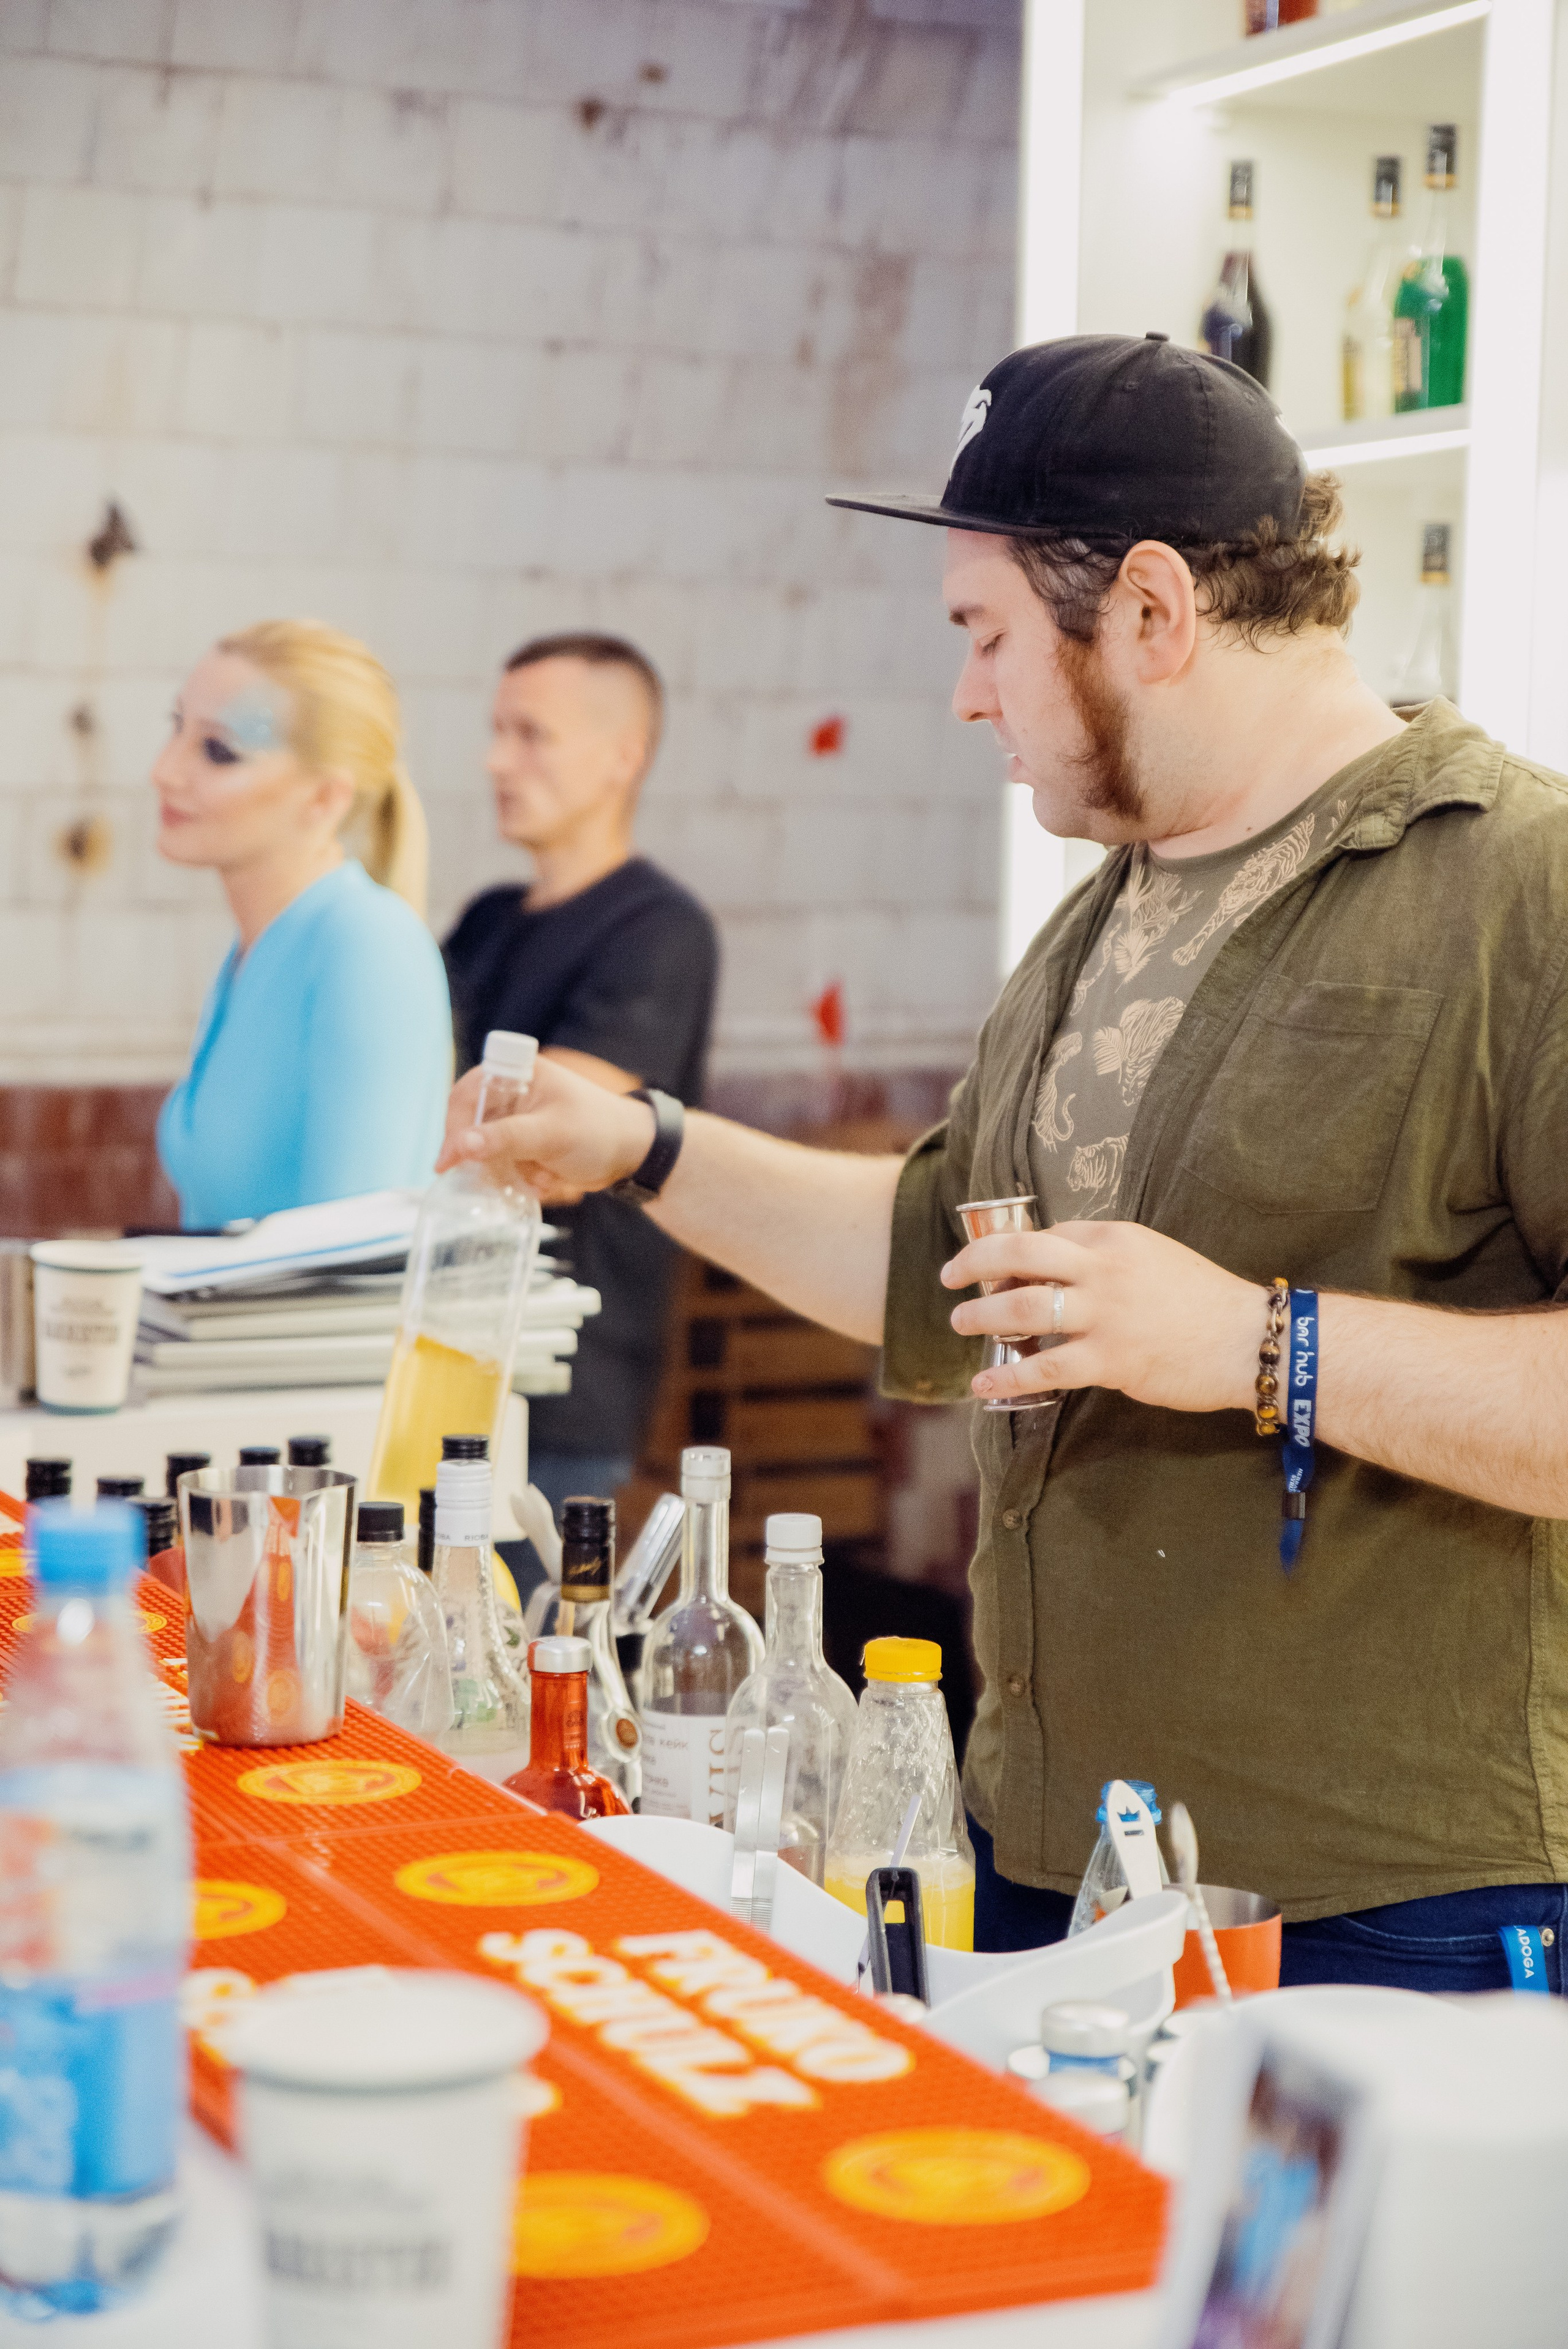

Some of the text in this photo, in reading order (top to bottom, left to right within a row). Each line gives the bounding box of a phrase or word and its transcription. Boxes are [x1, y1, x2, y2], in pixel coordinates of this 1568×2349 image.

[1294, 1316, 1315, 1447] bar hub EXPO
